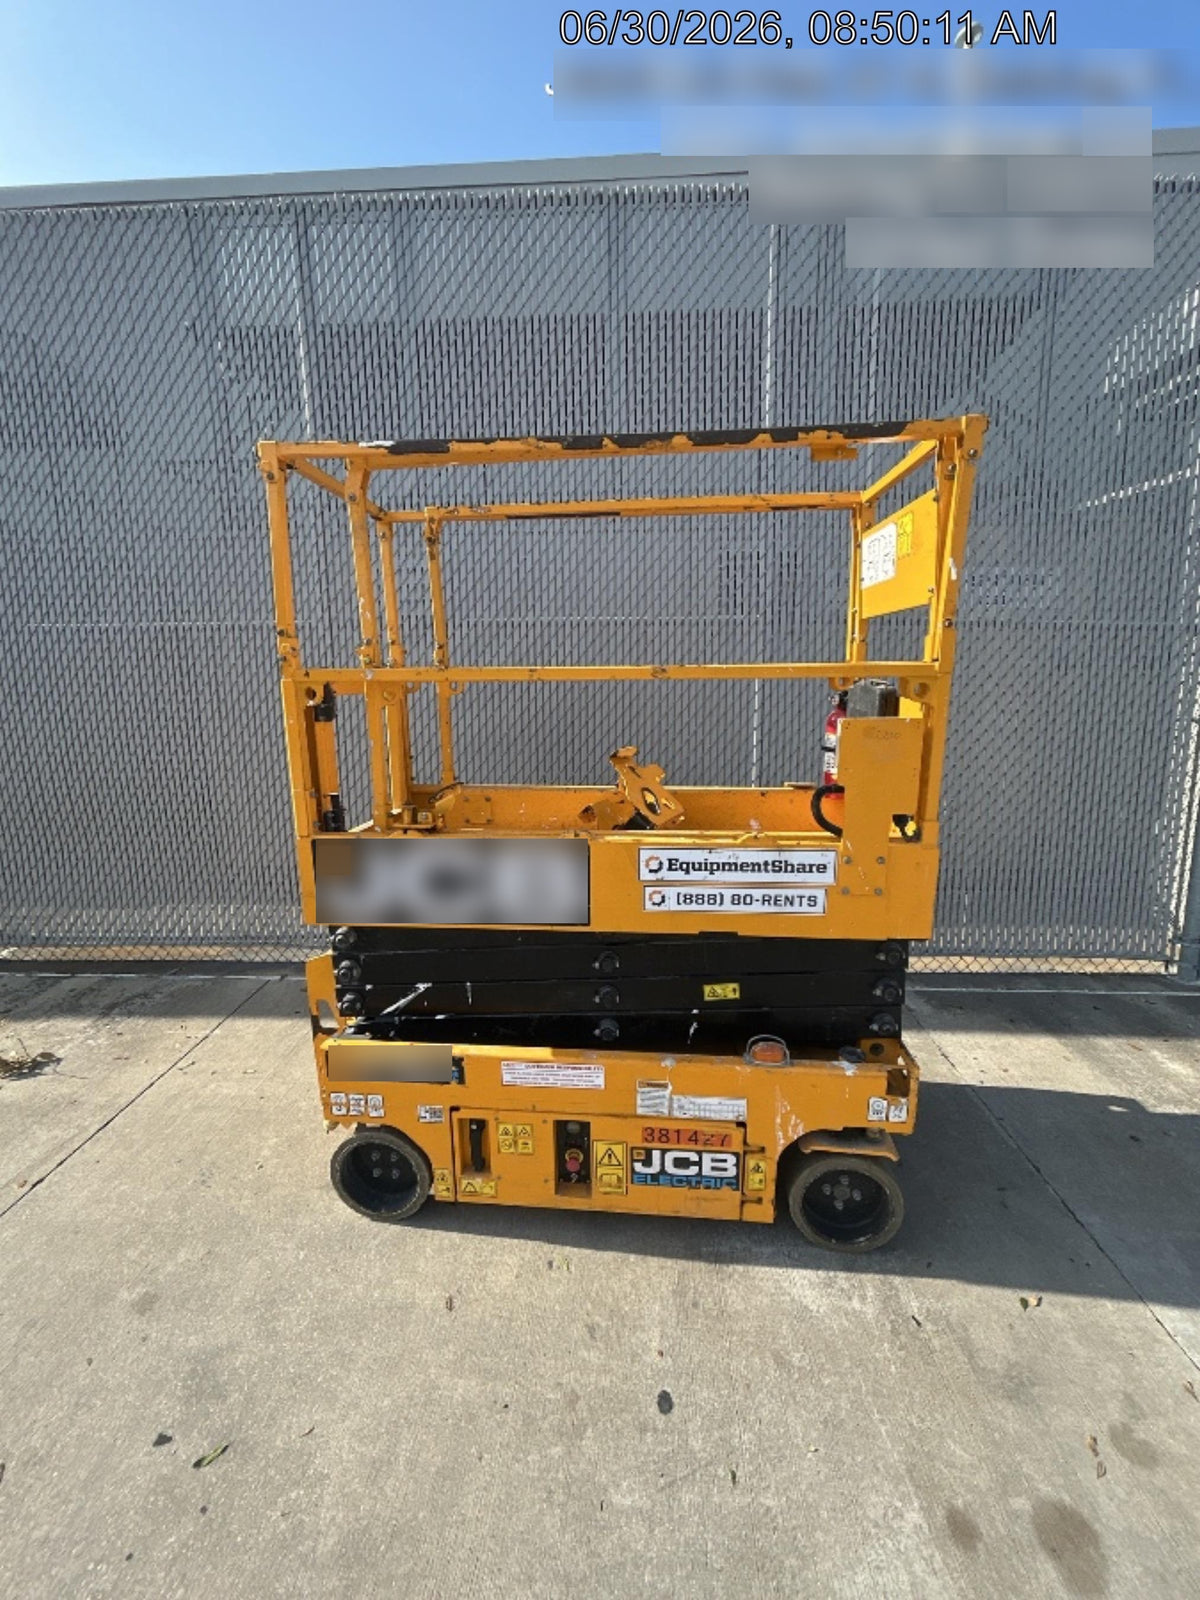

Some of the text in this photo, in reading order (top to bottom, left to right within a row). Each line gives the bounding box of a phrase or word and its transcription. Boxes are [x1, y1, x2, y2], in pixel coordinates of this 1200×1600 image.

[666, 857, 828, 875] EquipmentShare
[676, 892, 818, 908] (888) 80-RENTS
[633, 1149, 737, 1178] JCB
